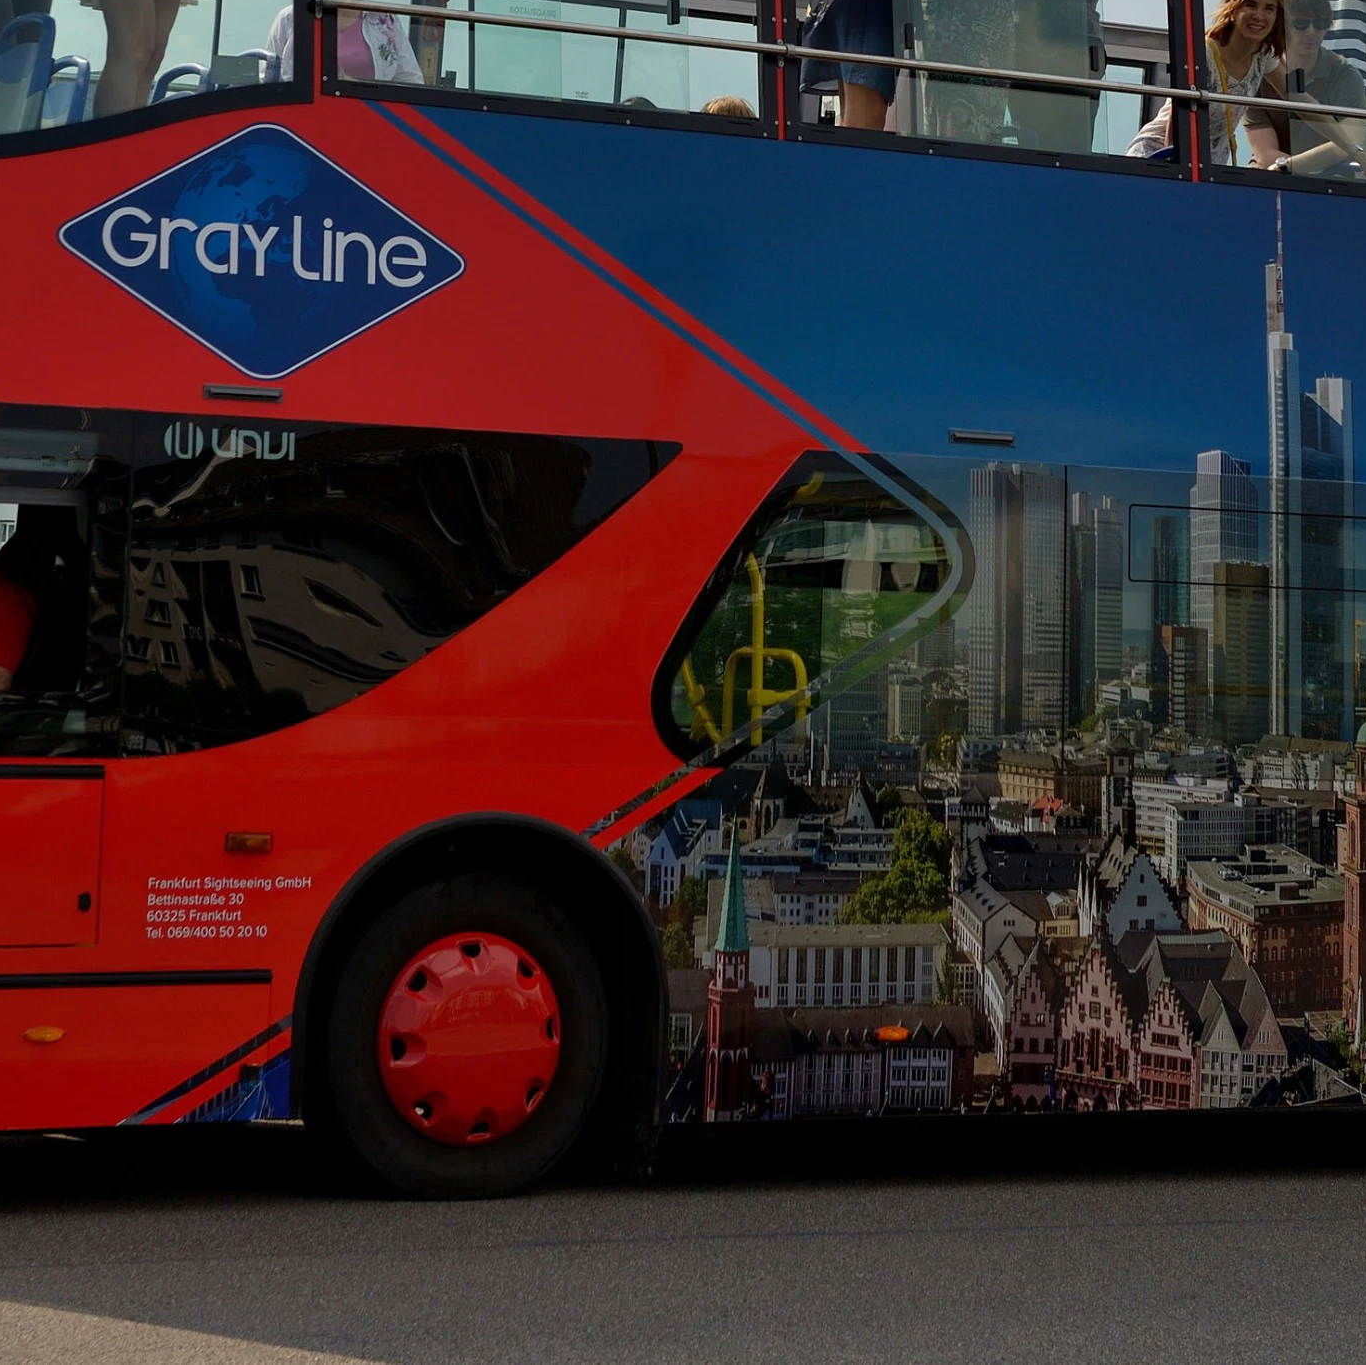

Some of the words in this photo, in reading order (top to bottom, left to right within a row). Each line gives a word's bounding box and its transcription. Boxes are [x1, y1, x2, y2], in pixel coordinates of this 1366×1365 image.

[509, 6, 557, 18] NOTAUSGANG
[101, 206, 280, 277] Gray
[293, 215, 428, 288] Line
[148, 877, 201, 889] Frankfurt
[204, 877, 272, 891] Sightseeing
[275, 876, 312, 888] GmbH
[147, 893, 226, 906] Bettinastraße
[229, 893, 244, 905] 30
[146, 910, 186, 922] 60325
[189, 910, 242, 921] Frankfurt
[146, 927, 164, 939] Tel.
[167, 926, 216, 938] 069/400
[219, 926, 234, 937] 50
[237, 926, 253, 937] 20
[255, 926, 268, 937] 10
